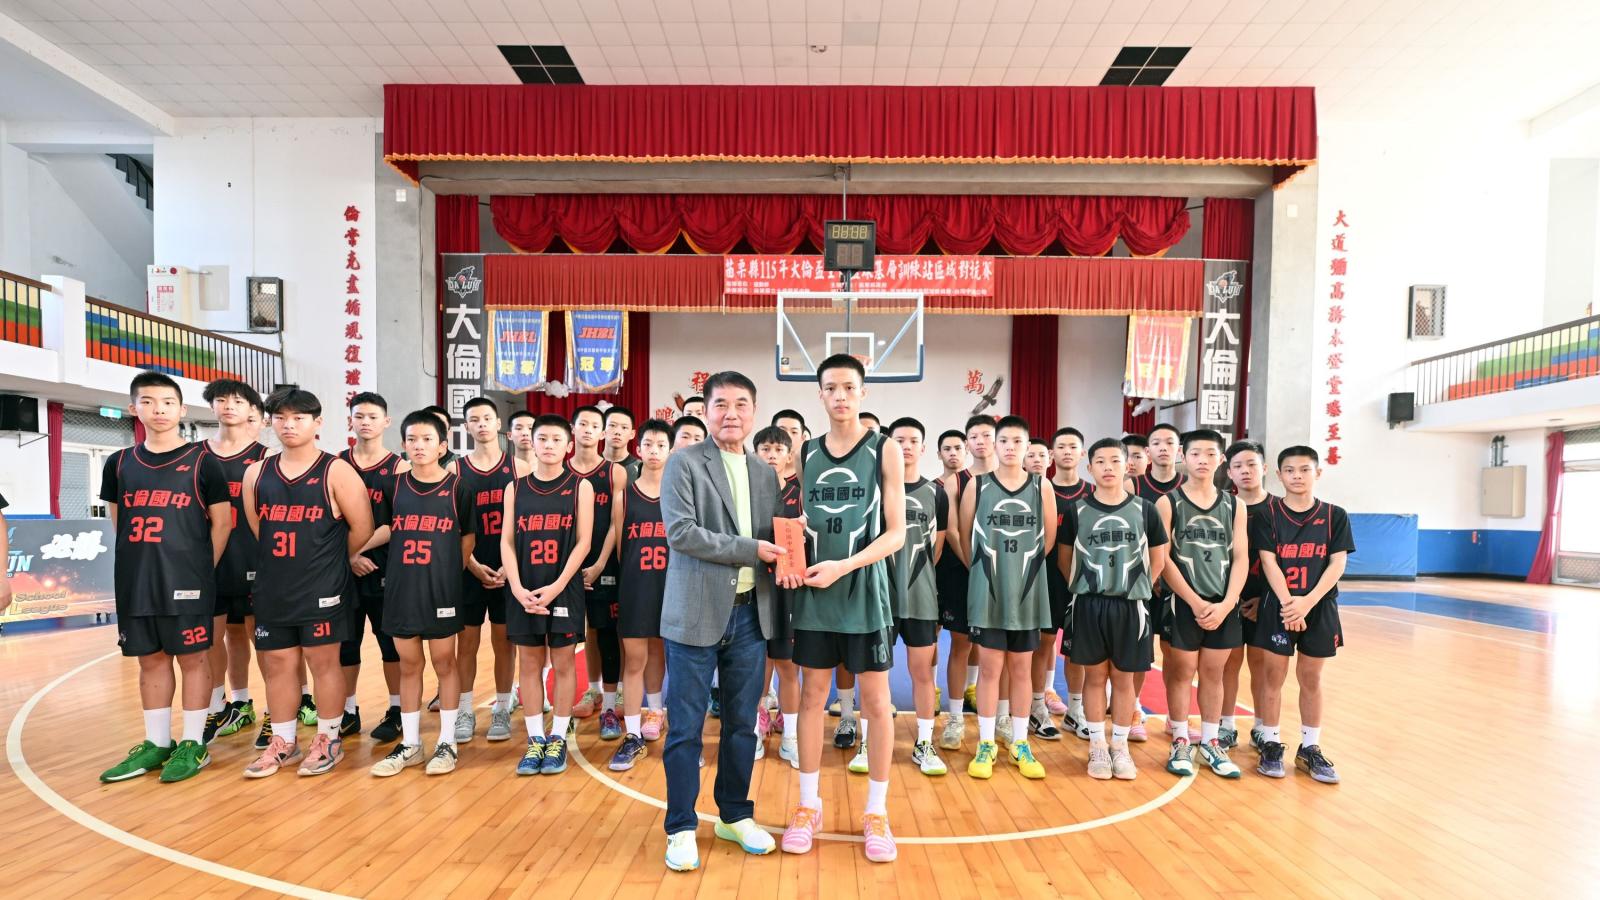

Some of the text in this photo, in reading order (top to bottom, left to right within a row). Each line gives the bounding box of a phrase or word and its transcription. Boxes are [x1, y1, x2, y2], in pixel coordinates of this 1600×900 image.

[578, 327, 615, 339] JHBL
[580, 356, 614, 372] 冠軍
[446, 303, 482, 457] 大倫國中
[964, 369, 985, 394] 萬
[1200, 308, 1241, 449] 大倫國
[123, 488, 192, 509] 大倫國中
[808, 486, 865, 503] 大倫國中
[259, 503, 324, 522] 大倫國中
[481, 510, 503, 535] 12
[986, 513, 1037, 527] 大倫國中
[128, 516, 164, 543] 32
[392, 514, 454, 533] 大倫國中
[516, 513, 573, 533] 大倫國中
[825, 516, 843, 535] 18
[272, 531, 297, 558] 31
[1003, 539, 1018, 553] 13
[1087, 529, 1137, 546] 大倫國中
[402, 539, 432, 565] 25
[530, 539, 559, 565] 28
[640, 545, 667, 571] 26
[1108, 554, 1115, 568] 3
[1203, 550, 1213, 563] 2
[1286, 566, 1308, 589] 21
[181, 626, 209, 646] 32
[312, 622, 331, 638] 31
[871, 643, 887, 664] 18
